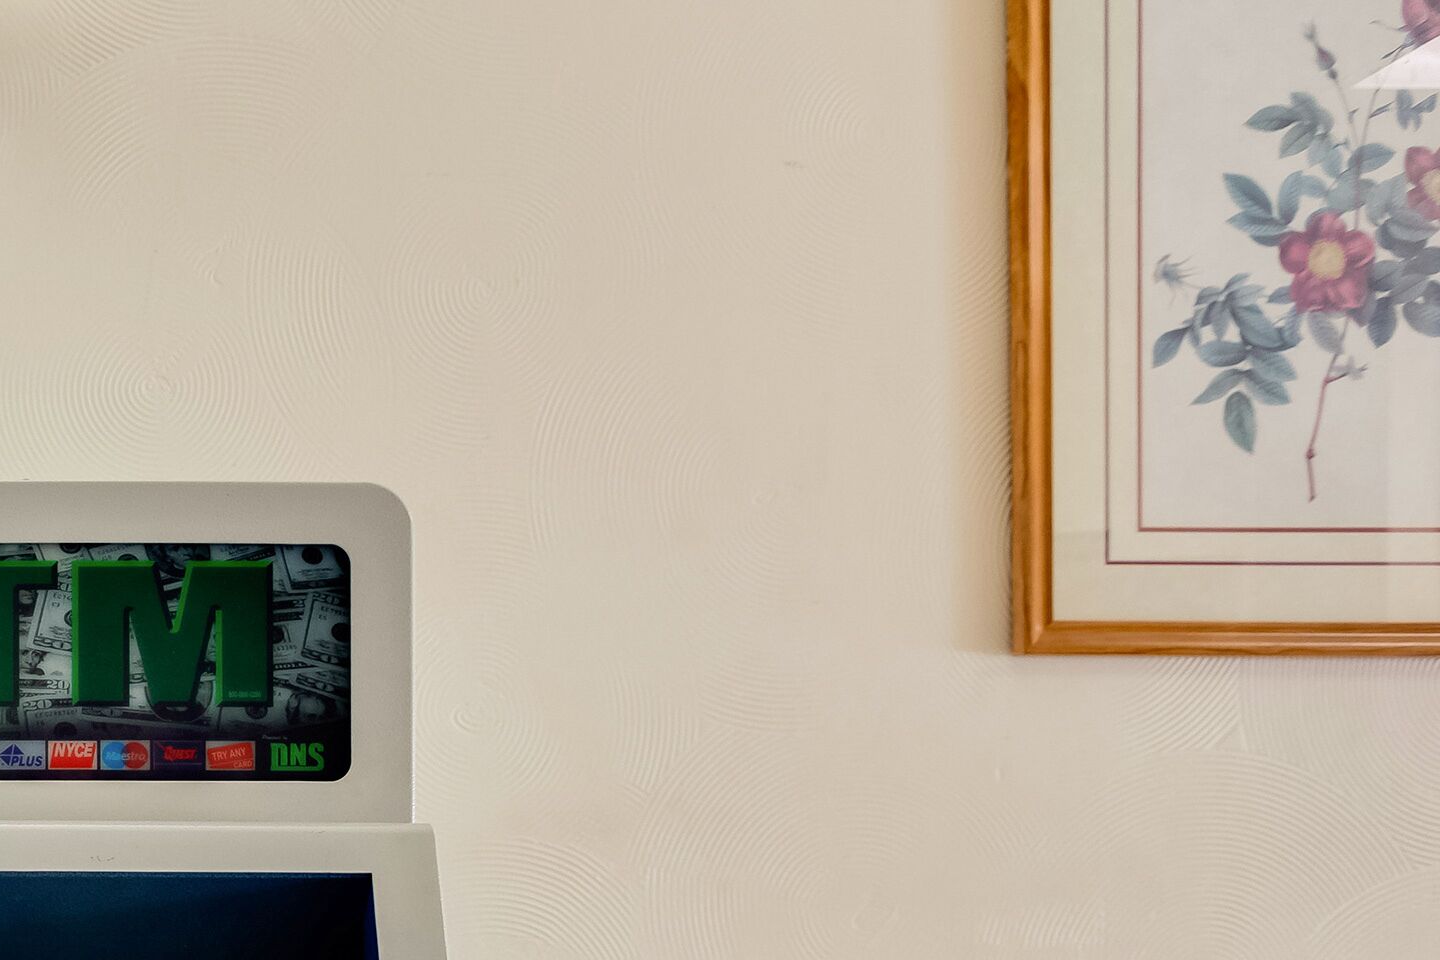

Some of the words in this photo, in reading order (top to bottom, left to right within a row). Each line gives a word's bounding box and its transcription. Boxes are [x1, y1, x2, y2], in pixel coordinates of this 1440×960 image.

[54, 742, 94, 757] NYCE
[211, 752, 229, 761] TRY
[229, 747, 246, 757] ANY
[11, 755, 43, 767] PLUS
